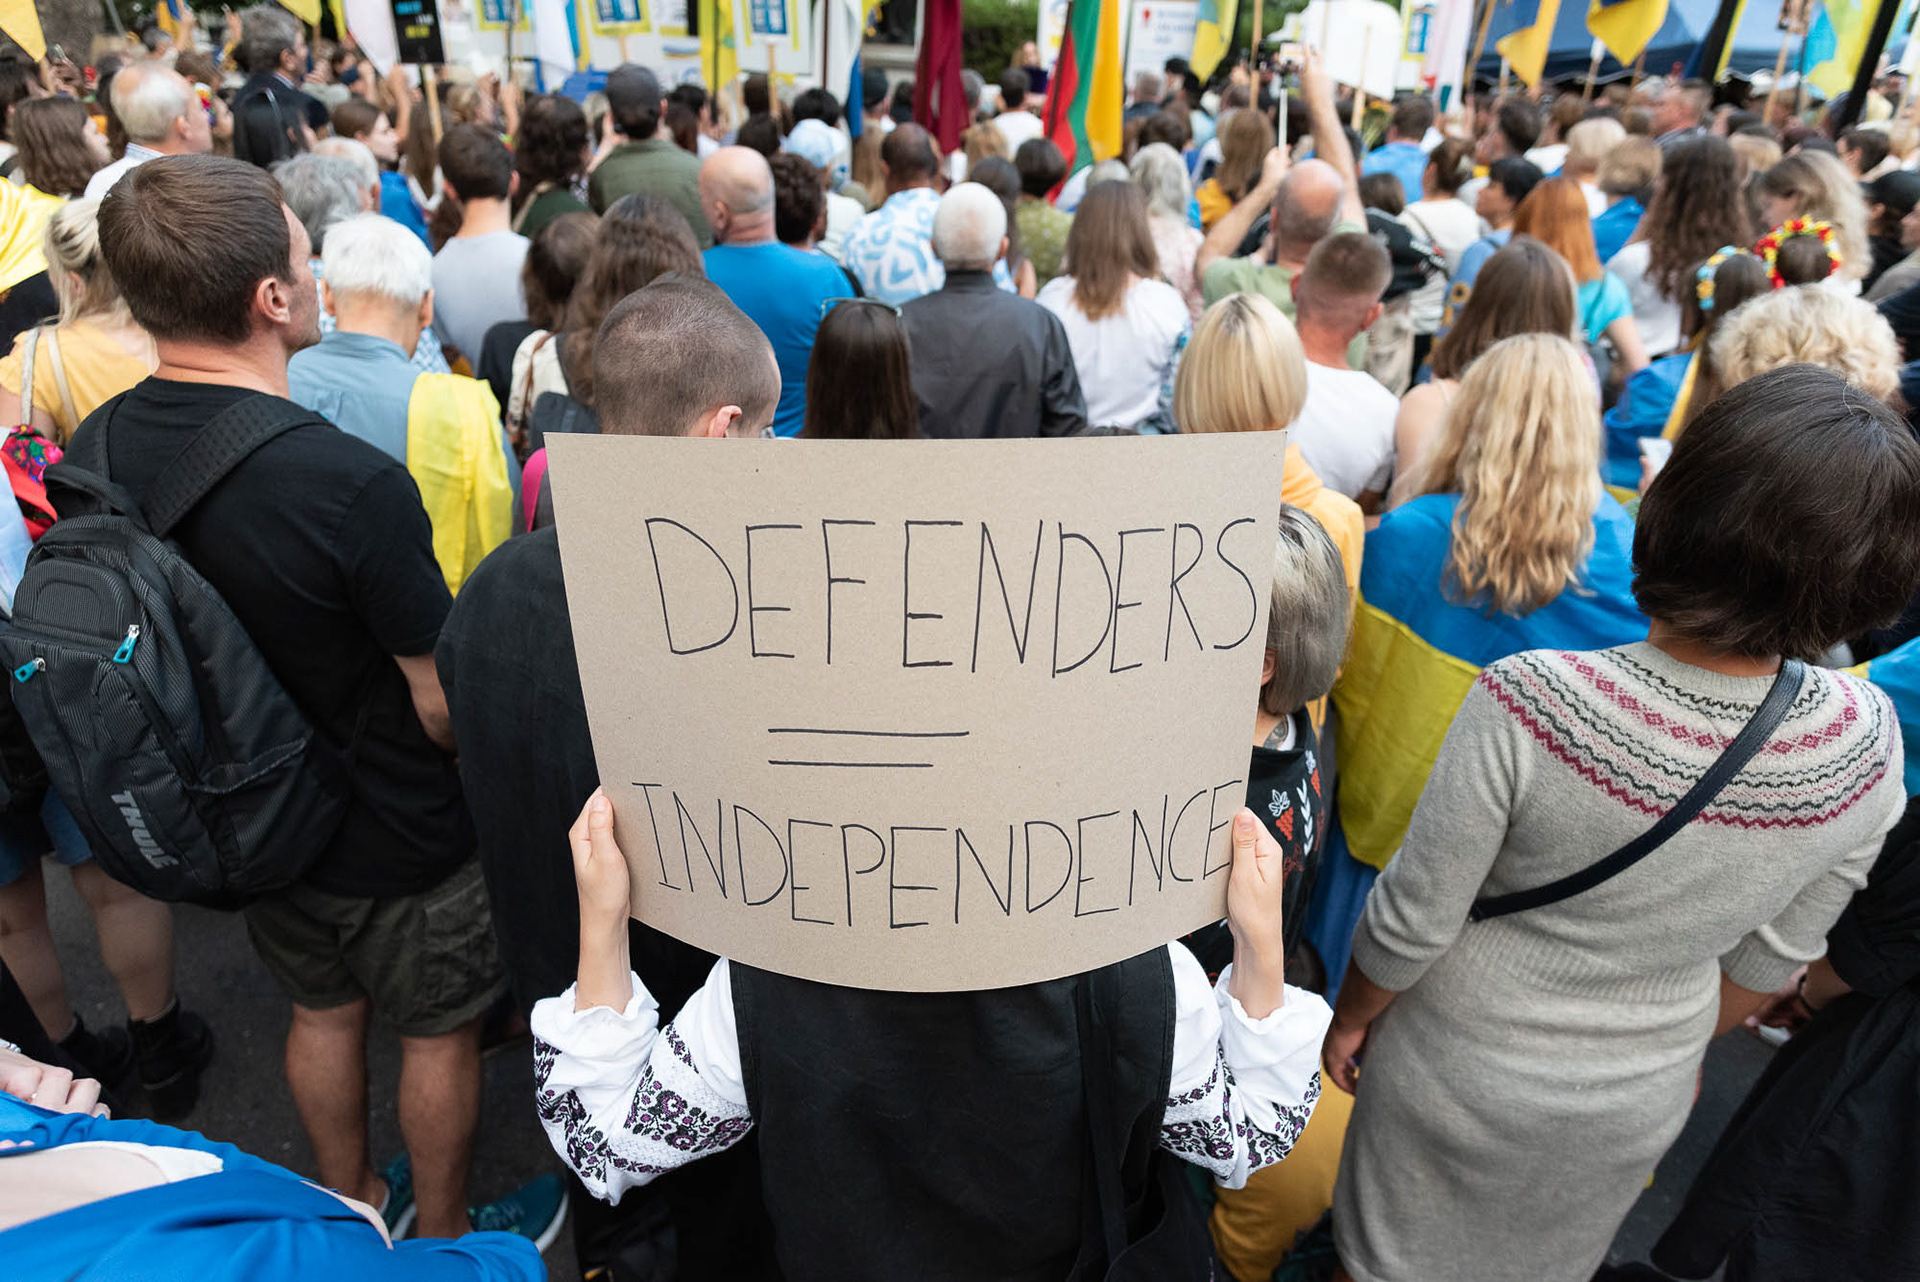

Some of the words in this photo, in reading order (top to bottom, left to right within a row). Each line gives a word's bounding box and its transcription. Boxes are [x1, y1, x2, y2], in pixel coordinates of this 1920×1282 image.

[645, 518, 1257, 679] DEFENDERS
[110, 789, 180, 870] THULE
[632, 779, 1243, 930] INDEPENDENCE
